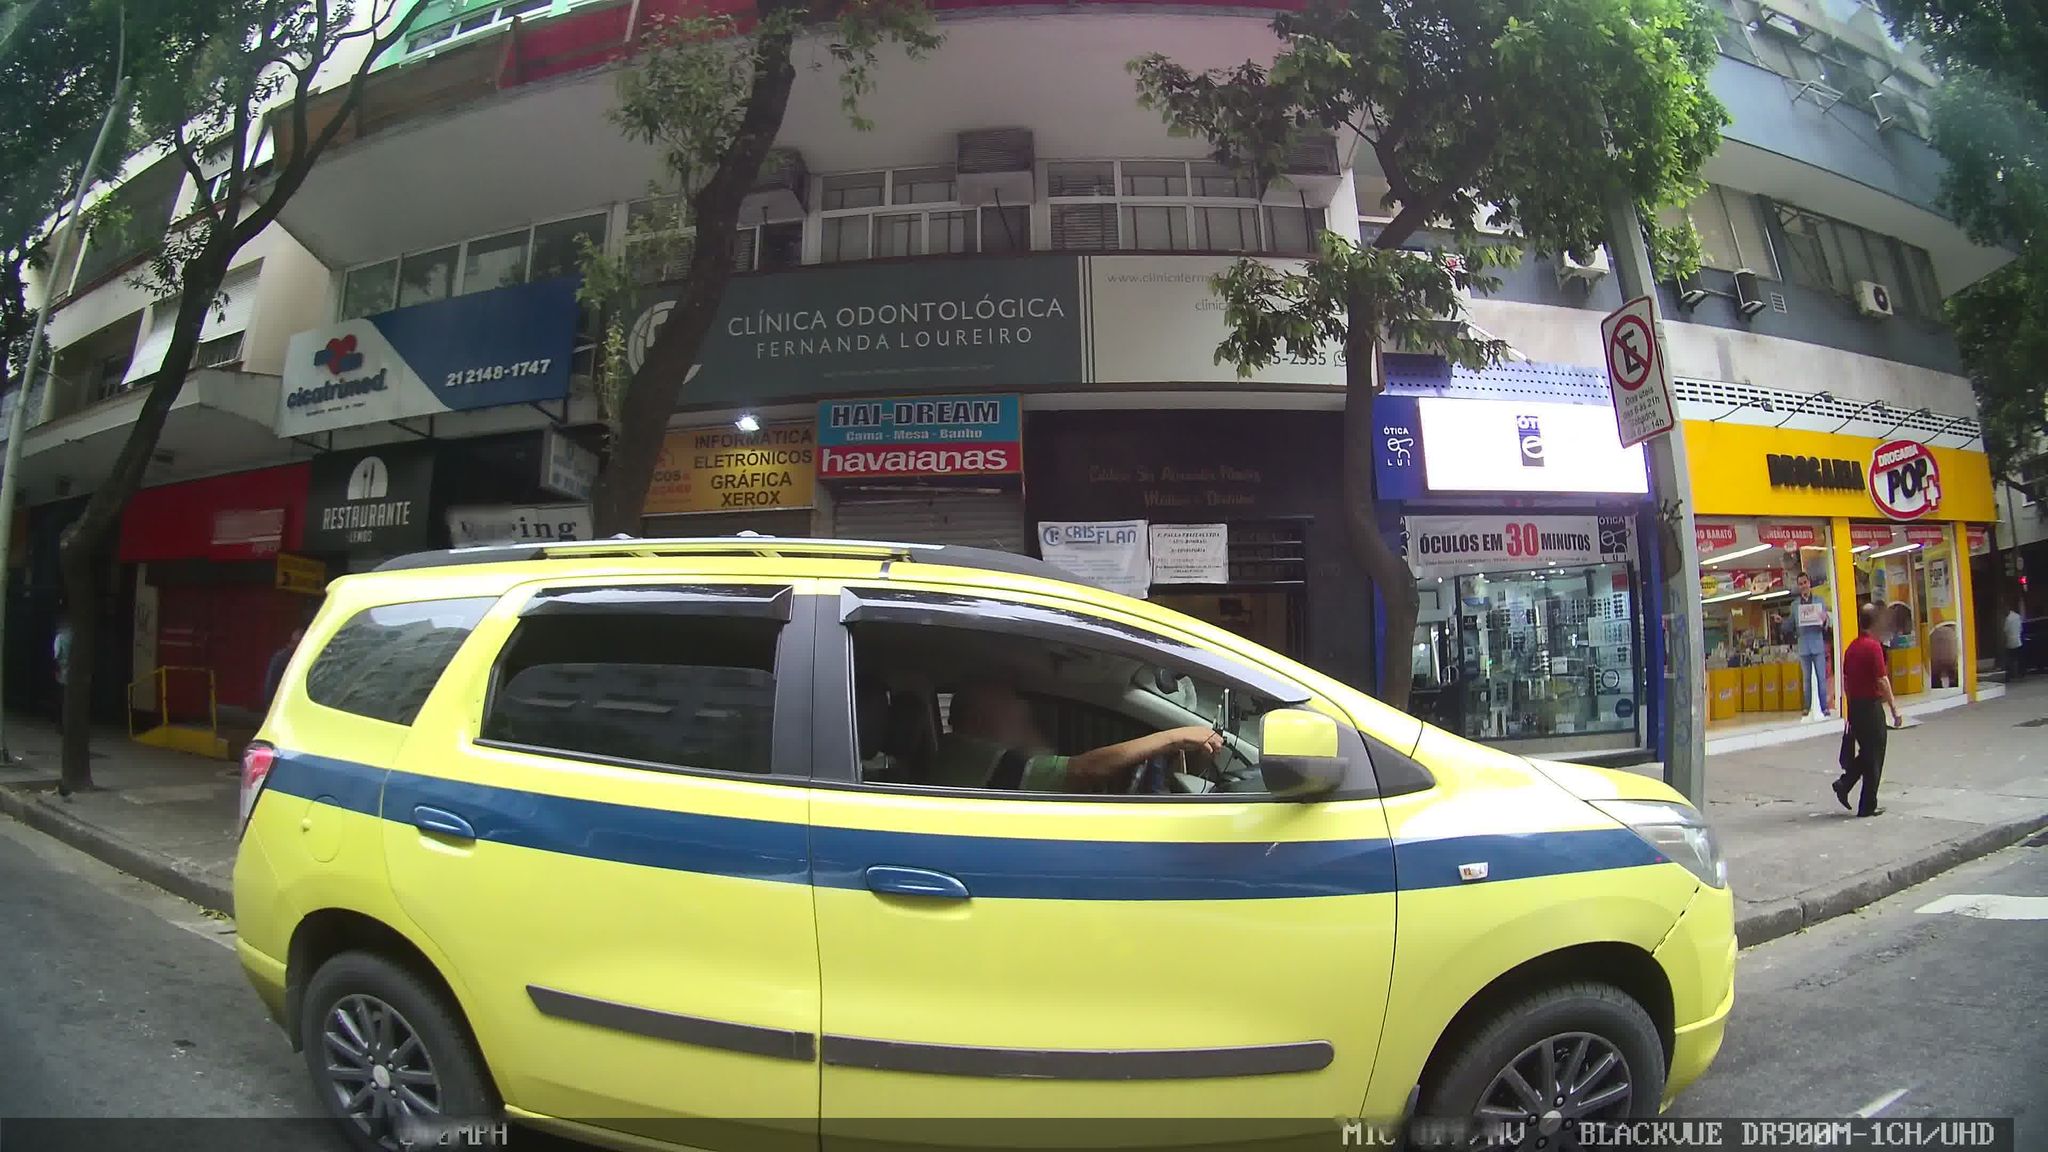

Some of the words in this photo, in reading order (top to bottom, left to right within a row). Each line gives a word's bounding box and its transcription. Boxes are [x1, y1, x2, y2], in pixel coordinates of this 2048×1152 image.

[727, 309, 827, 337] CLÍNICA
[836, 294, 1065, 328] ODONTOLÓGICA
[757, 335, 890, 359] FERNANDA
[900, 326, 1032, 349] LOUREIRO
[445, 372, 463, 388] 21
[465, 358, 551, 384] 2148-1747
[831, 400, 1001, 428] HAI-DREAM
[846, 432, 883, 441] Cama
[893, 430, 929, 440] Mesa
[938, 429, 982, 439] Banho
[1383, 425, 1409, 435] ÓTICA
[694, 450, 813, 469] ELETRÔNICOS
[822, 448, 1008, 473] havaianas
[711, 470, 792, 490] GRÁFICA
[1886, 458, 1928, 505] POP
[721, 491, 781, 508] XEROX
[322, 501, 411, 530] RESTAURANTE
[1419, 533, 1480, 555] ÓCULOS
[1482, 533, 1503, 551] EM
[1505, 522, 1538, 557] 30
[1540, 532, 1592, 551] MINUTOS
